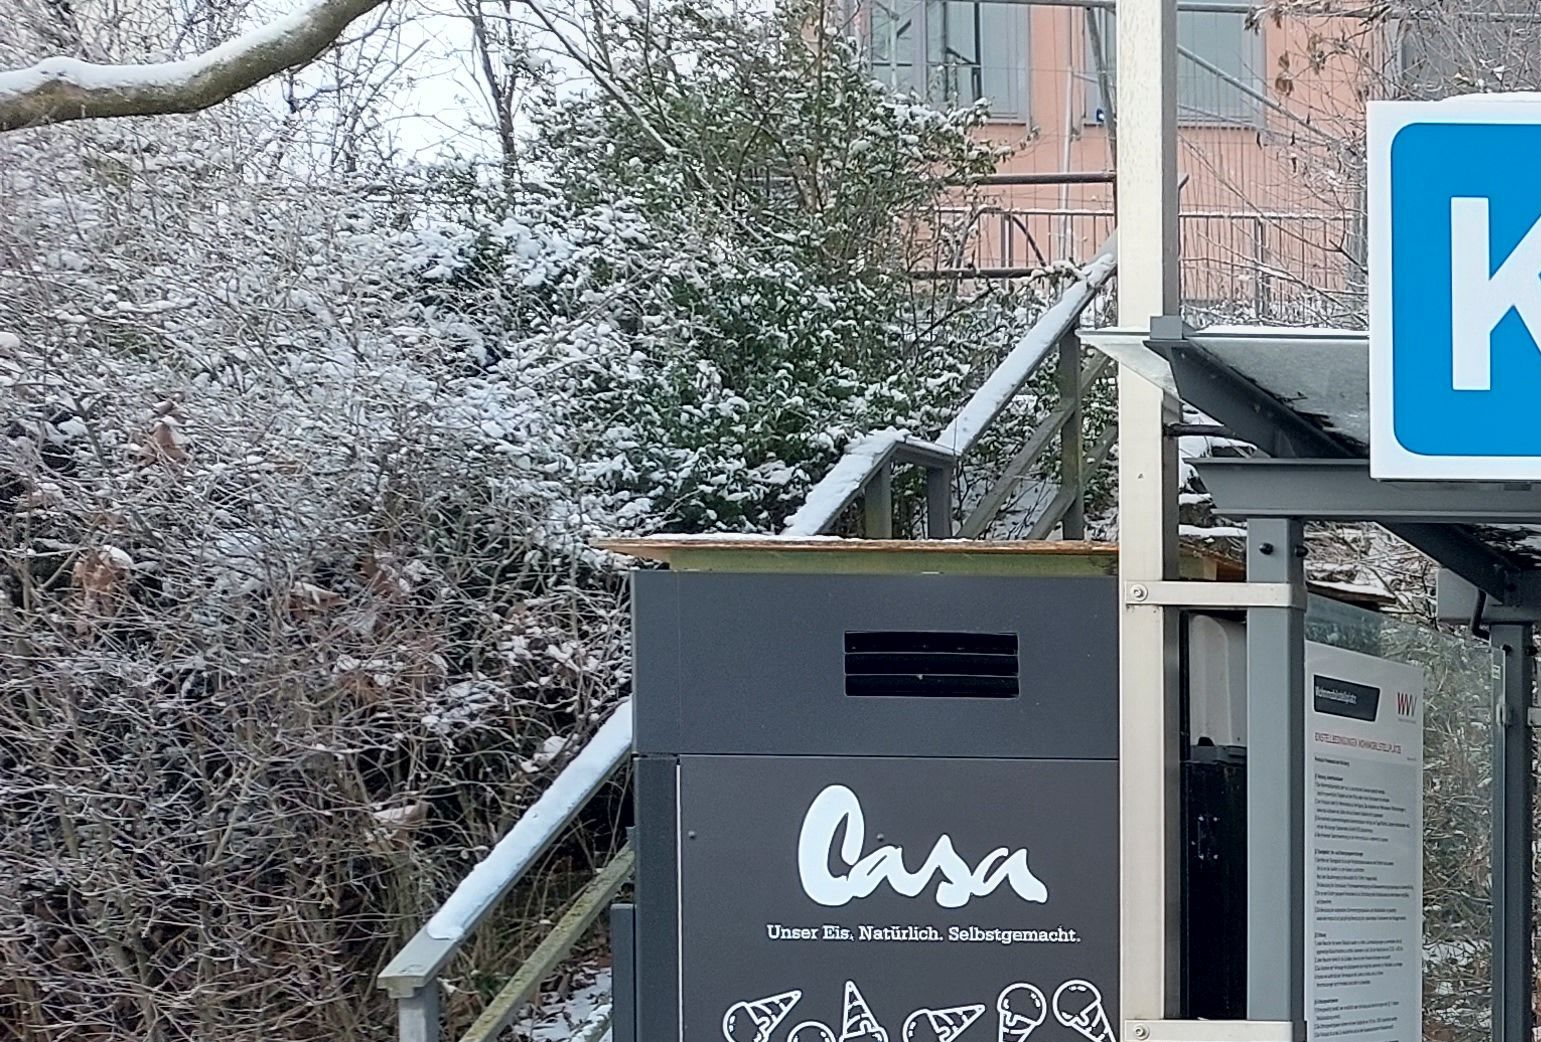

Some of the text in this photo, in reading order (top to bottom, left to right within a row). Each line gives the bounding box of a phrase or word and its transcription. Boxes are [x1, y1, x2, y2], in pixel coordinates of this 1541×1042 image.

[797, 784, 1048, 909] Casa
[766, 924, 818, 941] Unser
[858, 924, 944, 942] Natürlich.
[948, 924, 1081, 945] Selbstgemacht.
